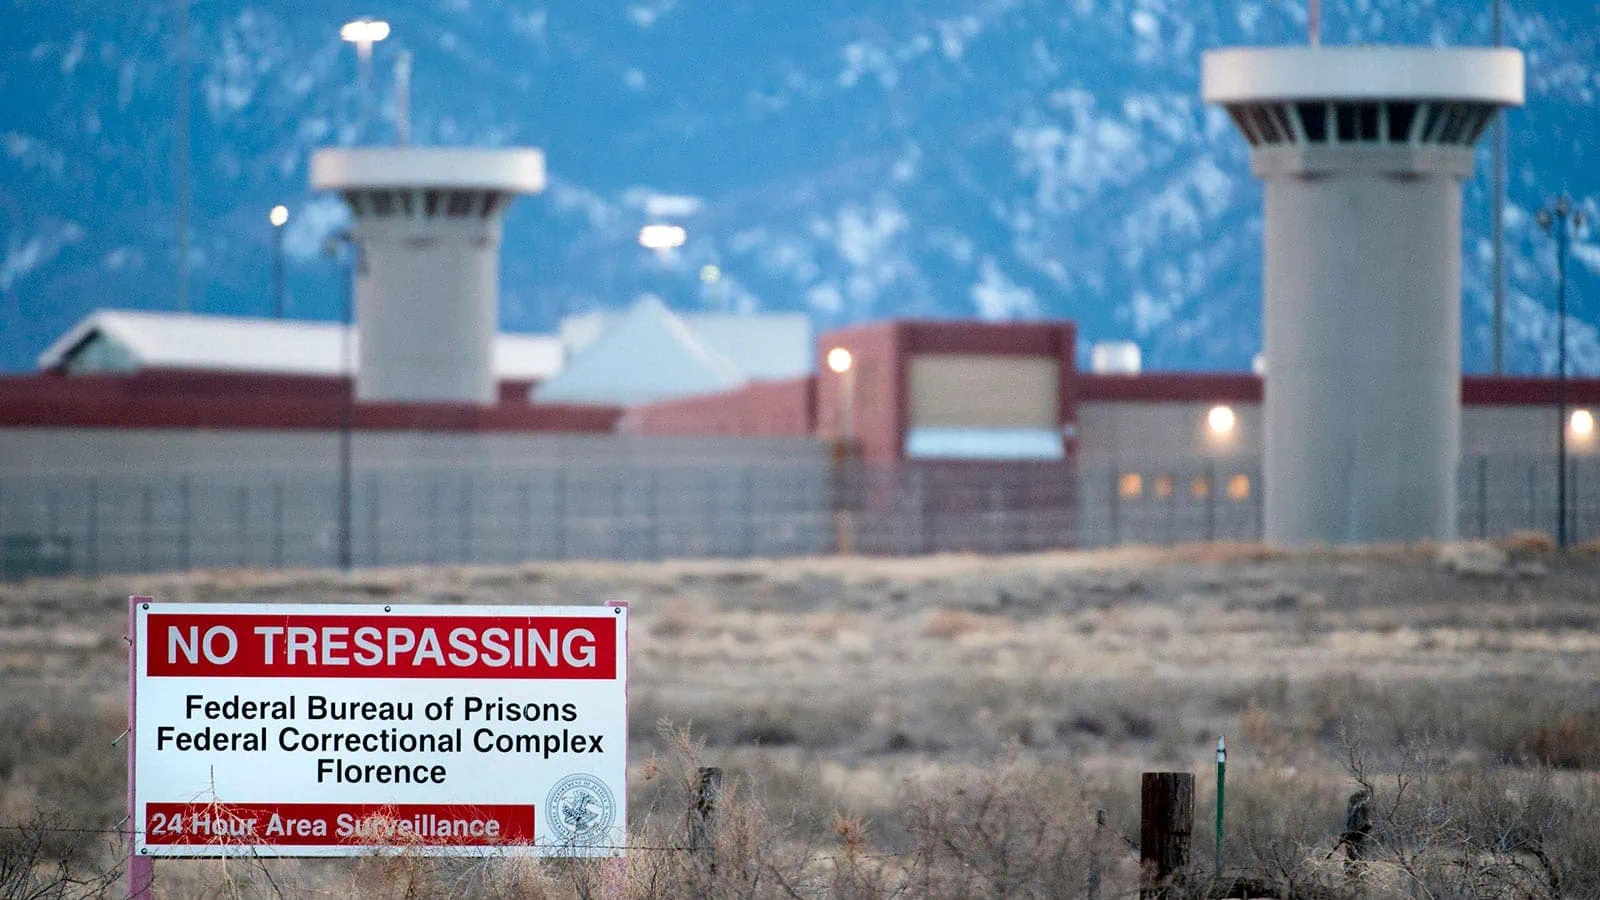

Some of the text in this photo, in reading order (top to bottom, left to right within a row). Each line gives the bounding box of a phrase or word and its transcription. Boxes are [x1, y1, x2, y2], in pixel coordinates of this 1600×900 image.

[167, 625, 596, 667] NO TRESPASSING
[186, 695, 577, 722] Federal Bureau of Prisons
[157, 727, 603, 758] Federal Correctional Complex
[317, 759, 446, 783] Florence
[151, 812, 500, 837] 24 Hour Area Surveillance
